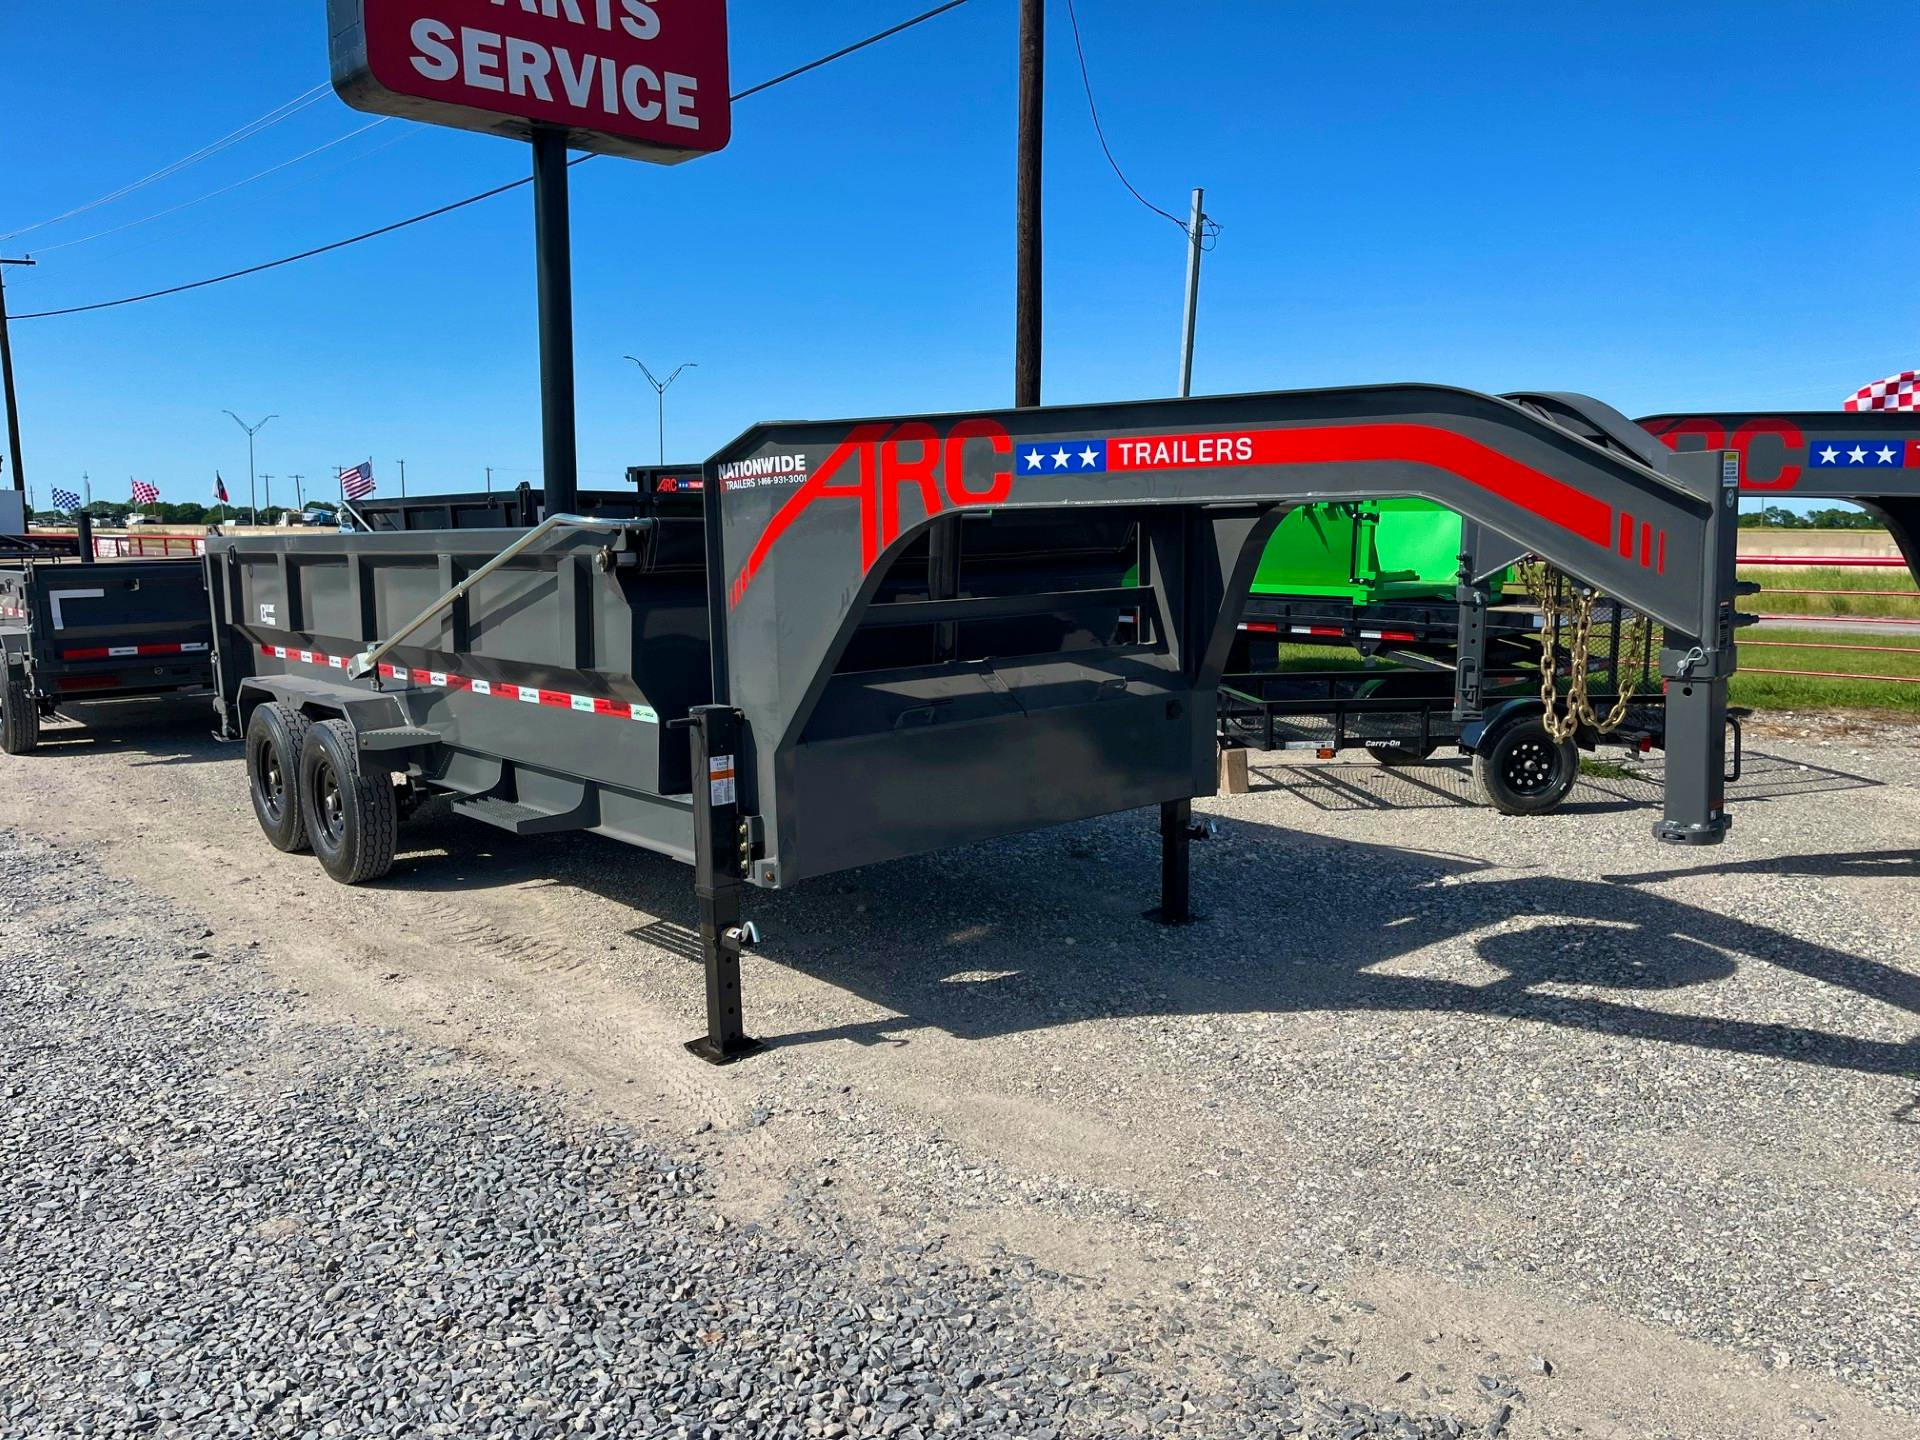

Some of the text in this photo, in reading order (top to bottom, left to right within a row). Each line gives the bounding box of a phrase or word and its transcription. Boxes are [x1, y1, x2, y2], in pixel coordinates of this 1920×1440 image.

[409, 18, 700, 130] SERVICE
[717, 454, 807, 480] NATIONWIDE
[726, 478, 756, 491] TRAILERS
[729, 418, 1253, 613] ARC TRAILERS
[1365, 740, 1401, 748] Carry-On
